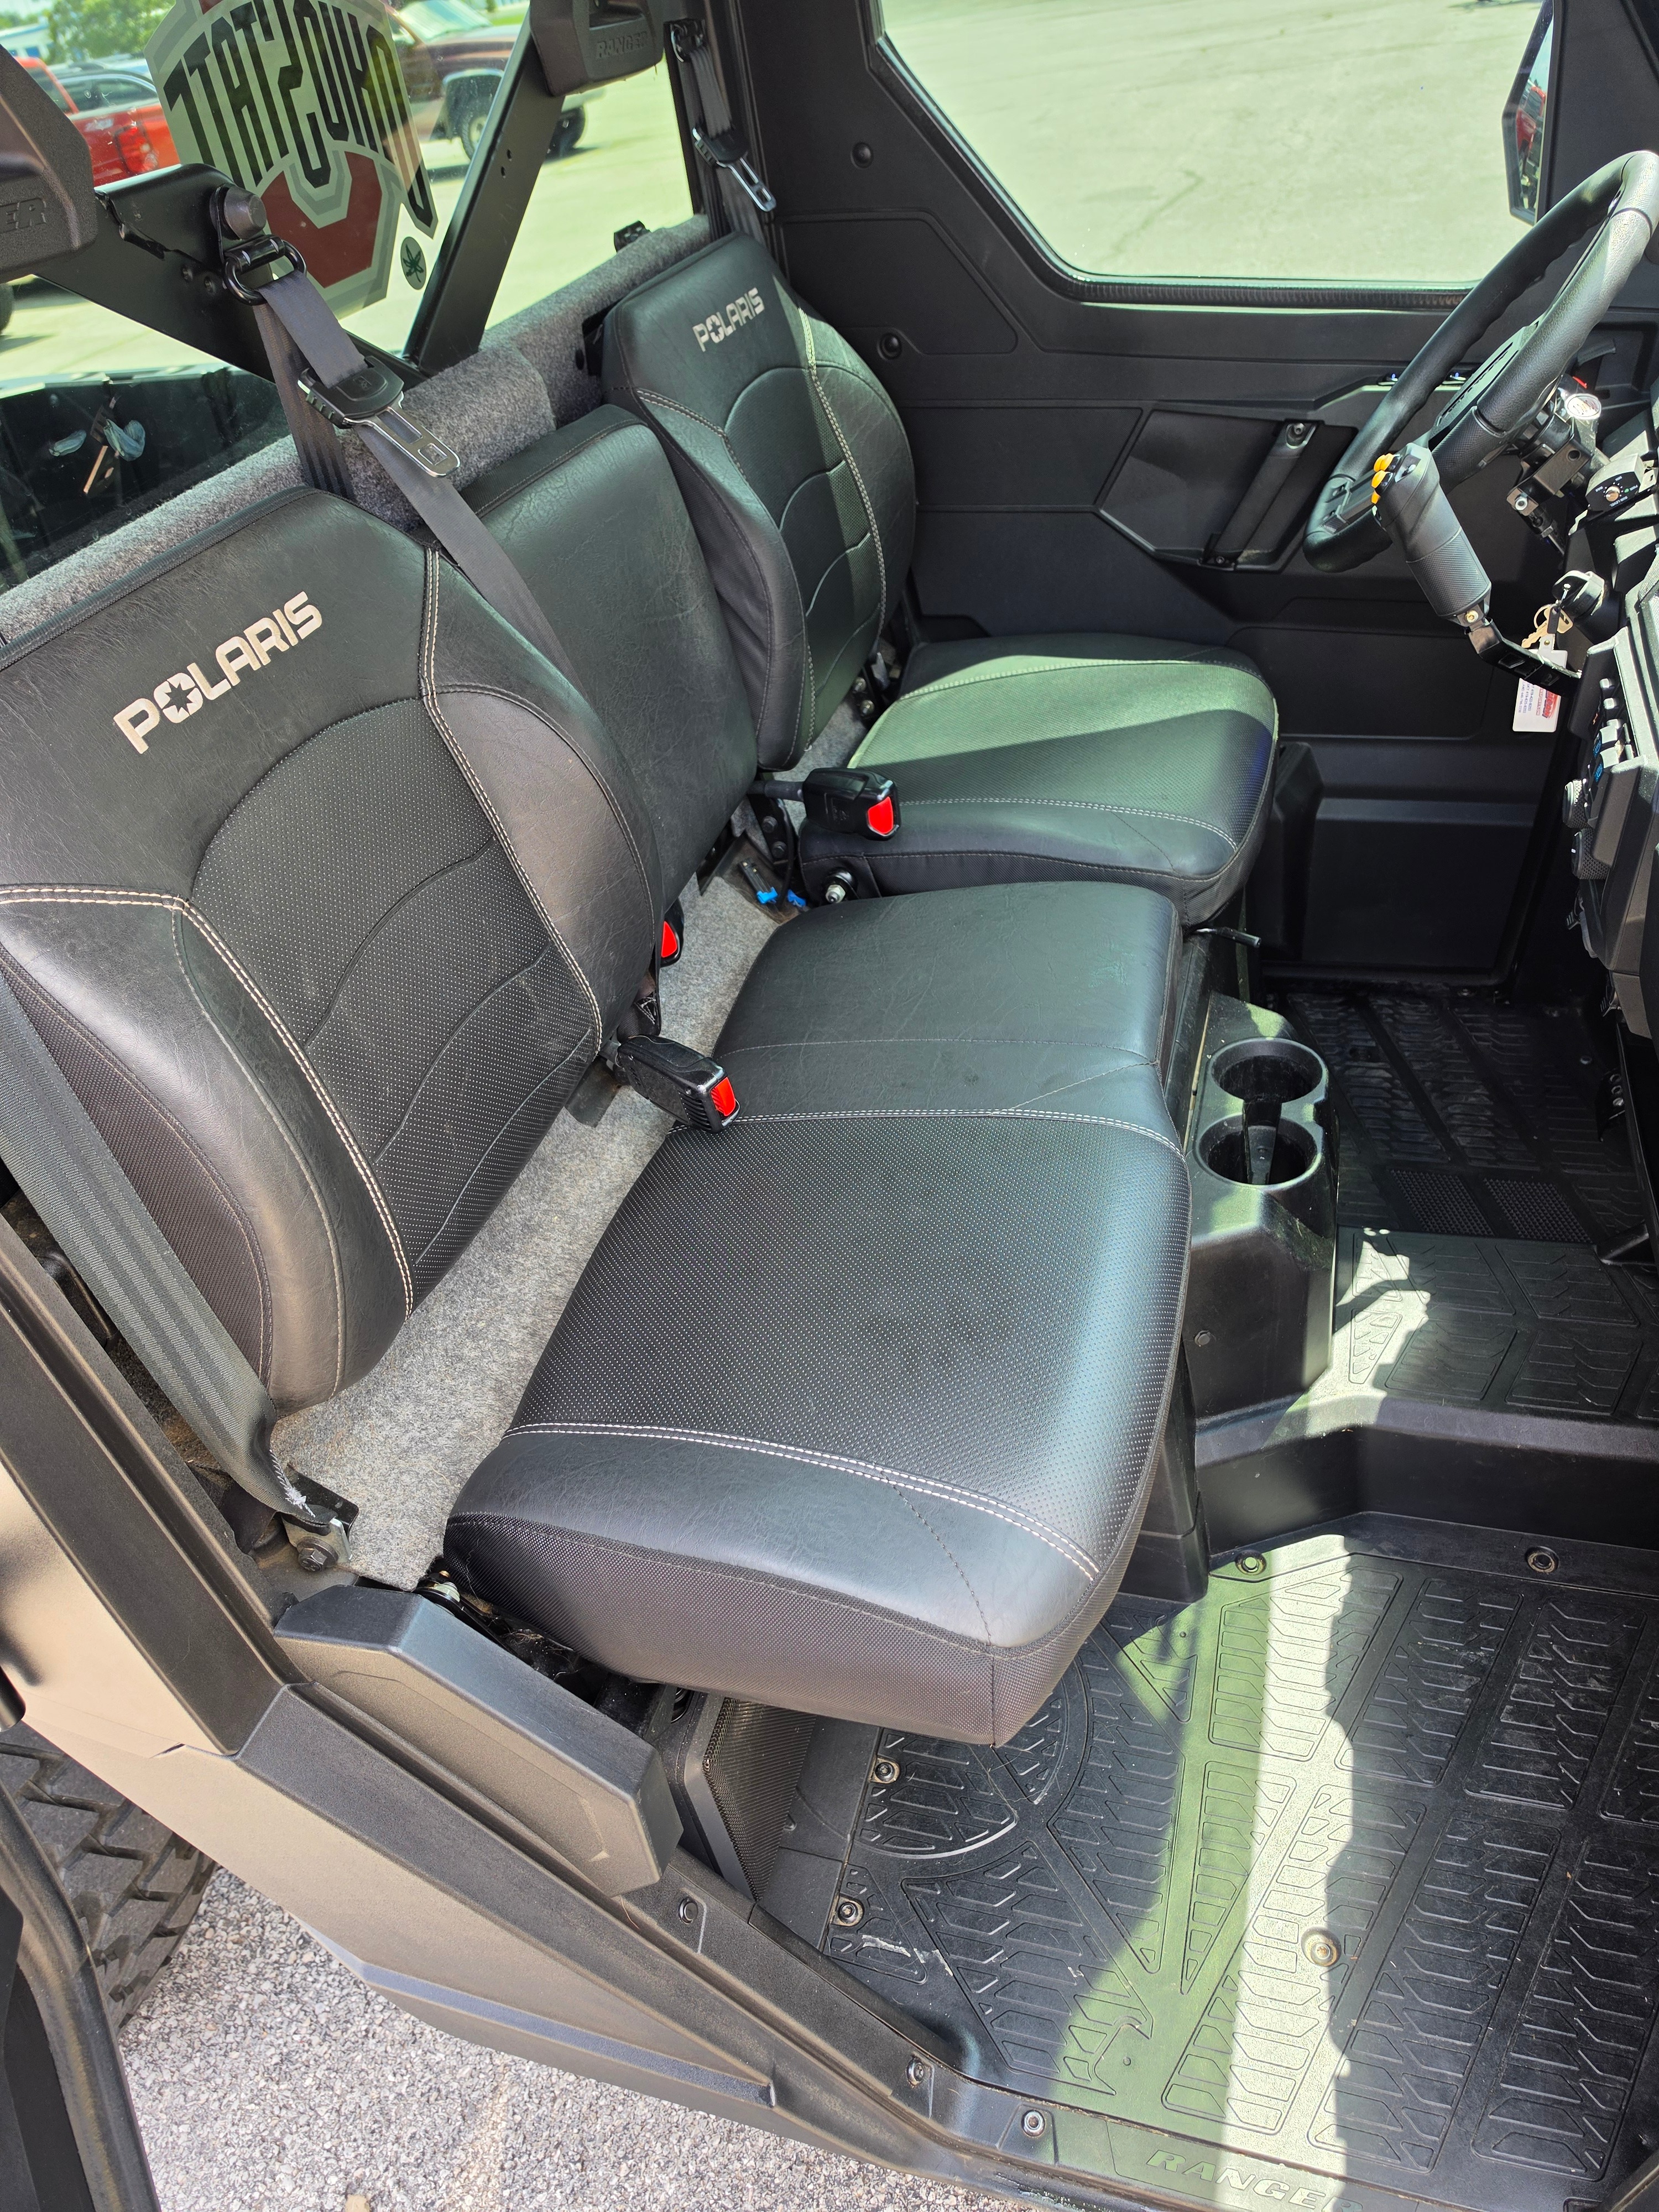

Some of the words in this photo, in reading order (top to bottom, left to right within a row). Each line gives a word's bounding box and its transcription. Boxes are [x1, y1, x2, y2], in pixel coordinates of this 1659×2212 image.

[692, 287, 765, 352] POLARIS
[113, 591, 322, 754] POLARIS
[1146, 2150, 1363, 2212] RANGER
